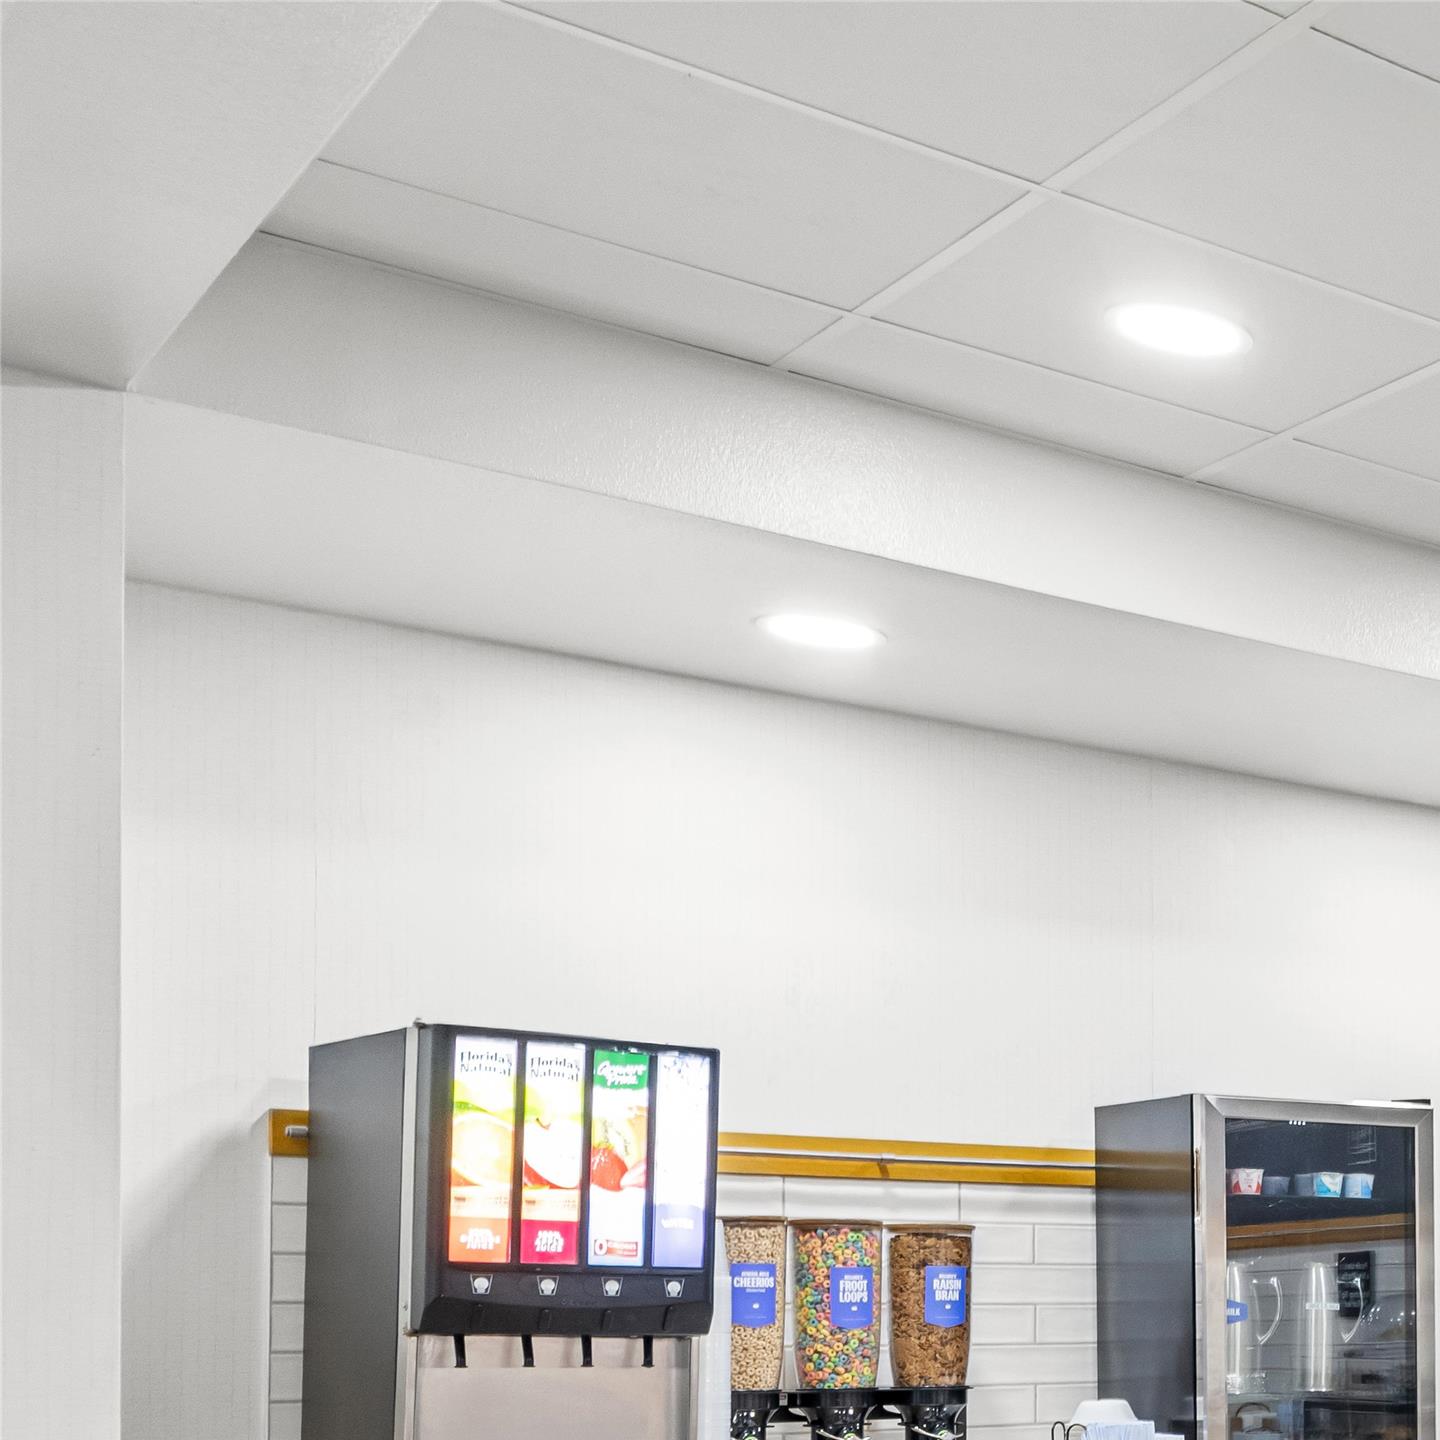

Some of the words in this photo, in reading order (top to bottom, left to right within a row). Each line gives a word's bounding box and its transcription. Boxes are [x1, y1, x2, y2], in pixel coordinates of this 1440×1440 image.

[733, 1276, 775, 1288] CHEERIOS
[839, 1280, 868, 1291] FROOT
[933, 1279, 962, 1290] RAISIN
[839, 1291, 868, 1303] LOOPS
[935, 1289, 960, 1301] BRAN
